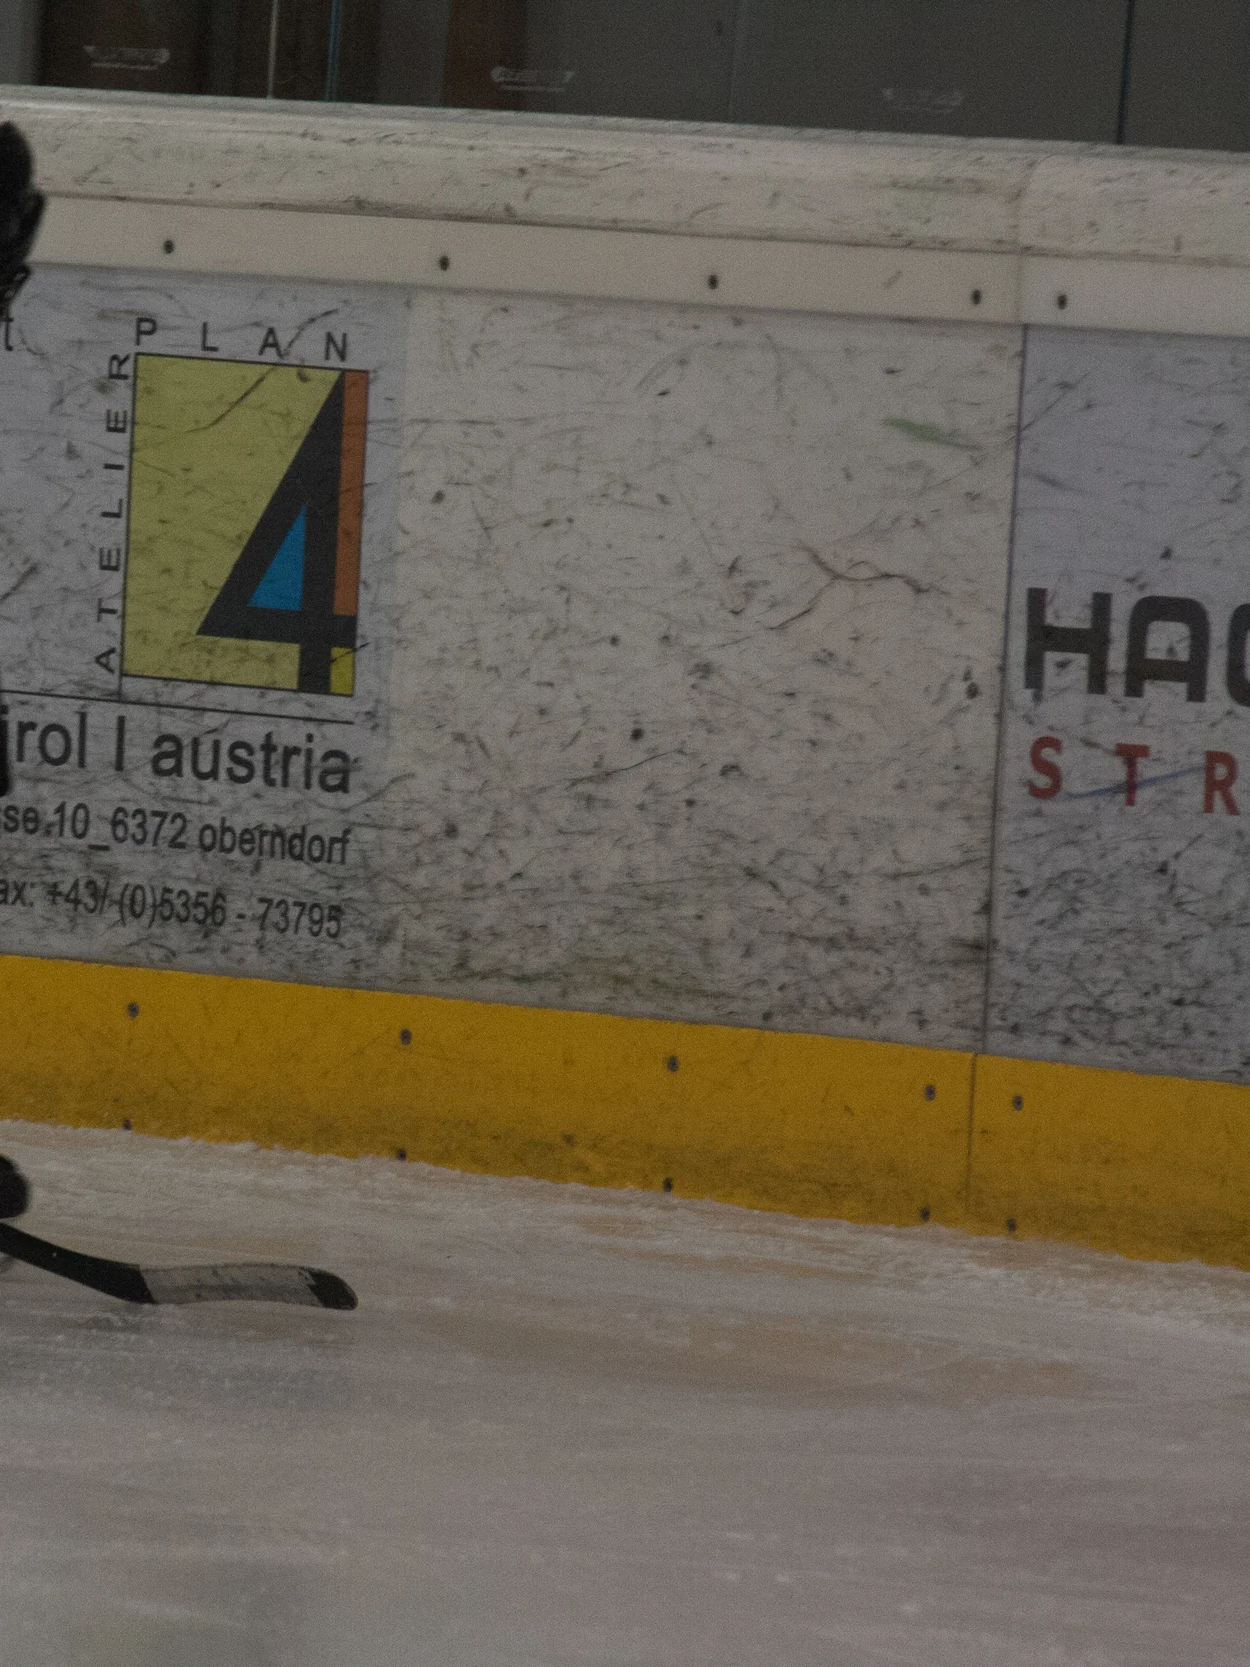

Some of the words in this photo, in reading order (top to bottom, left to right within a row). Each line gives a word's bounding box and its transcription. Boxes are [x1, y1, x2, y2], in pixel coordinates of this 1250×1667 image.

[94, 352, 131, 674] ATELIER
[150, 730, 352, 795] austria
[199, 815, 352, 865] oberndorf
[257, 896, 344, 939] 73795
